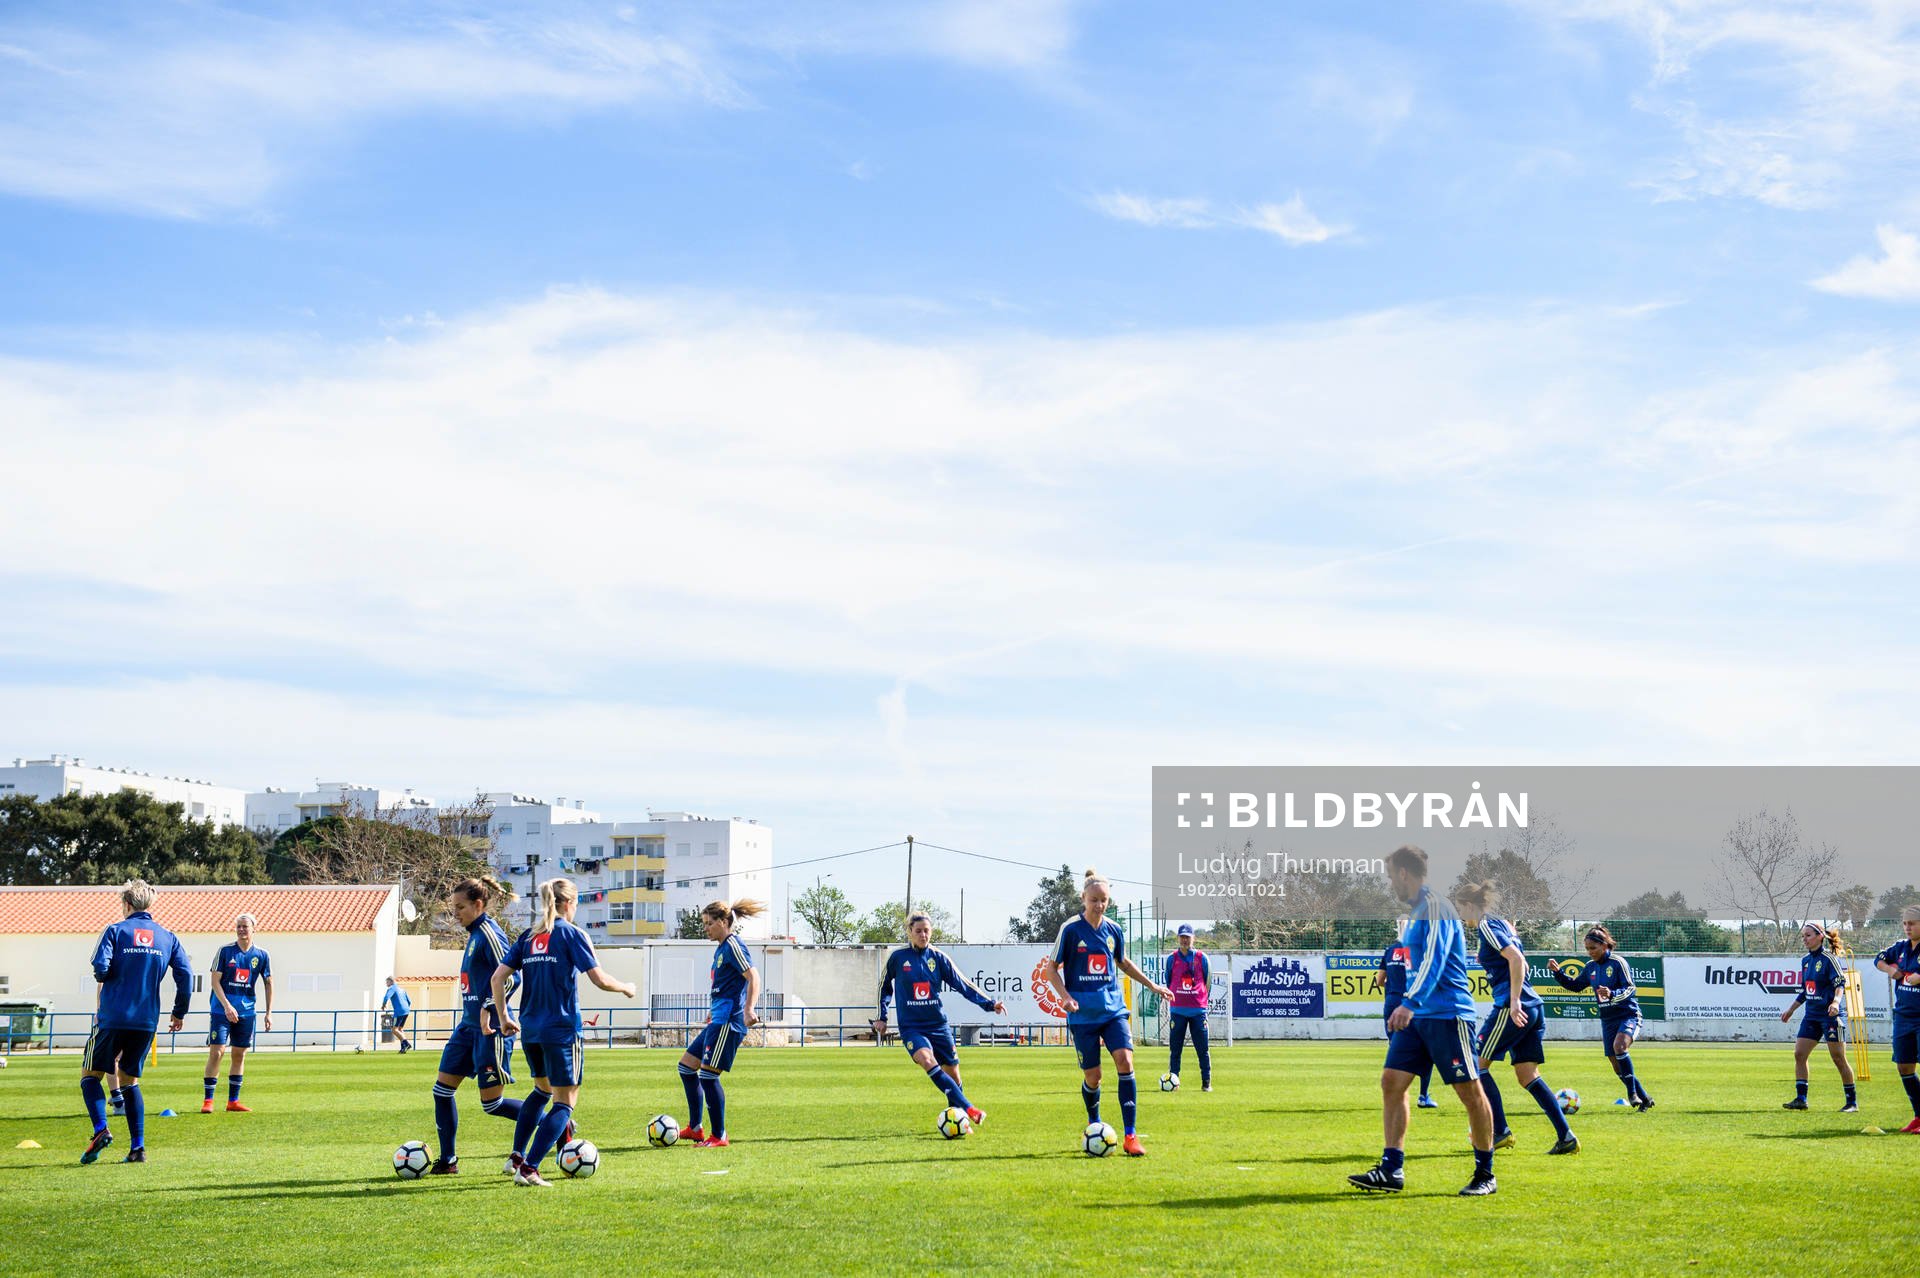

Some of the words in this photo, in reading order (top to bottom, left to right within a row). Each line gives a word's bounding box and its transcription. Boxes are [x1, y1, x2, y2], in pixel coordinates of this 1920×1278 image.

[123, 947, 149, 955] SVENSKA
[149, 949, 163, 957] SPEL
[523, 956, 545, 964] SVENSKA
[545, 955, 558, 963] SPEL
[1340, 958, 1372, 967] FUTEBOL
[1373, 958, 1383, 967] C
[1630, 967, 1657, 979] dical
[1249, 972, 1305, 987] Alb-Style
[1331, 971, 1383, 995] ESTÁ
[1239, 988, 1262, 997] GESTÃO
[1263, 989, 1267, 997] E
[1268, 988, 1316, 998] ADMINISTRAÇÃO
[1288, 1008, 1300, 1016] 325
